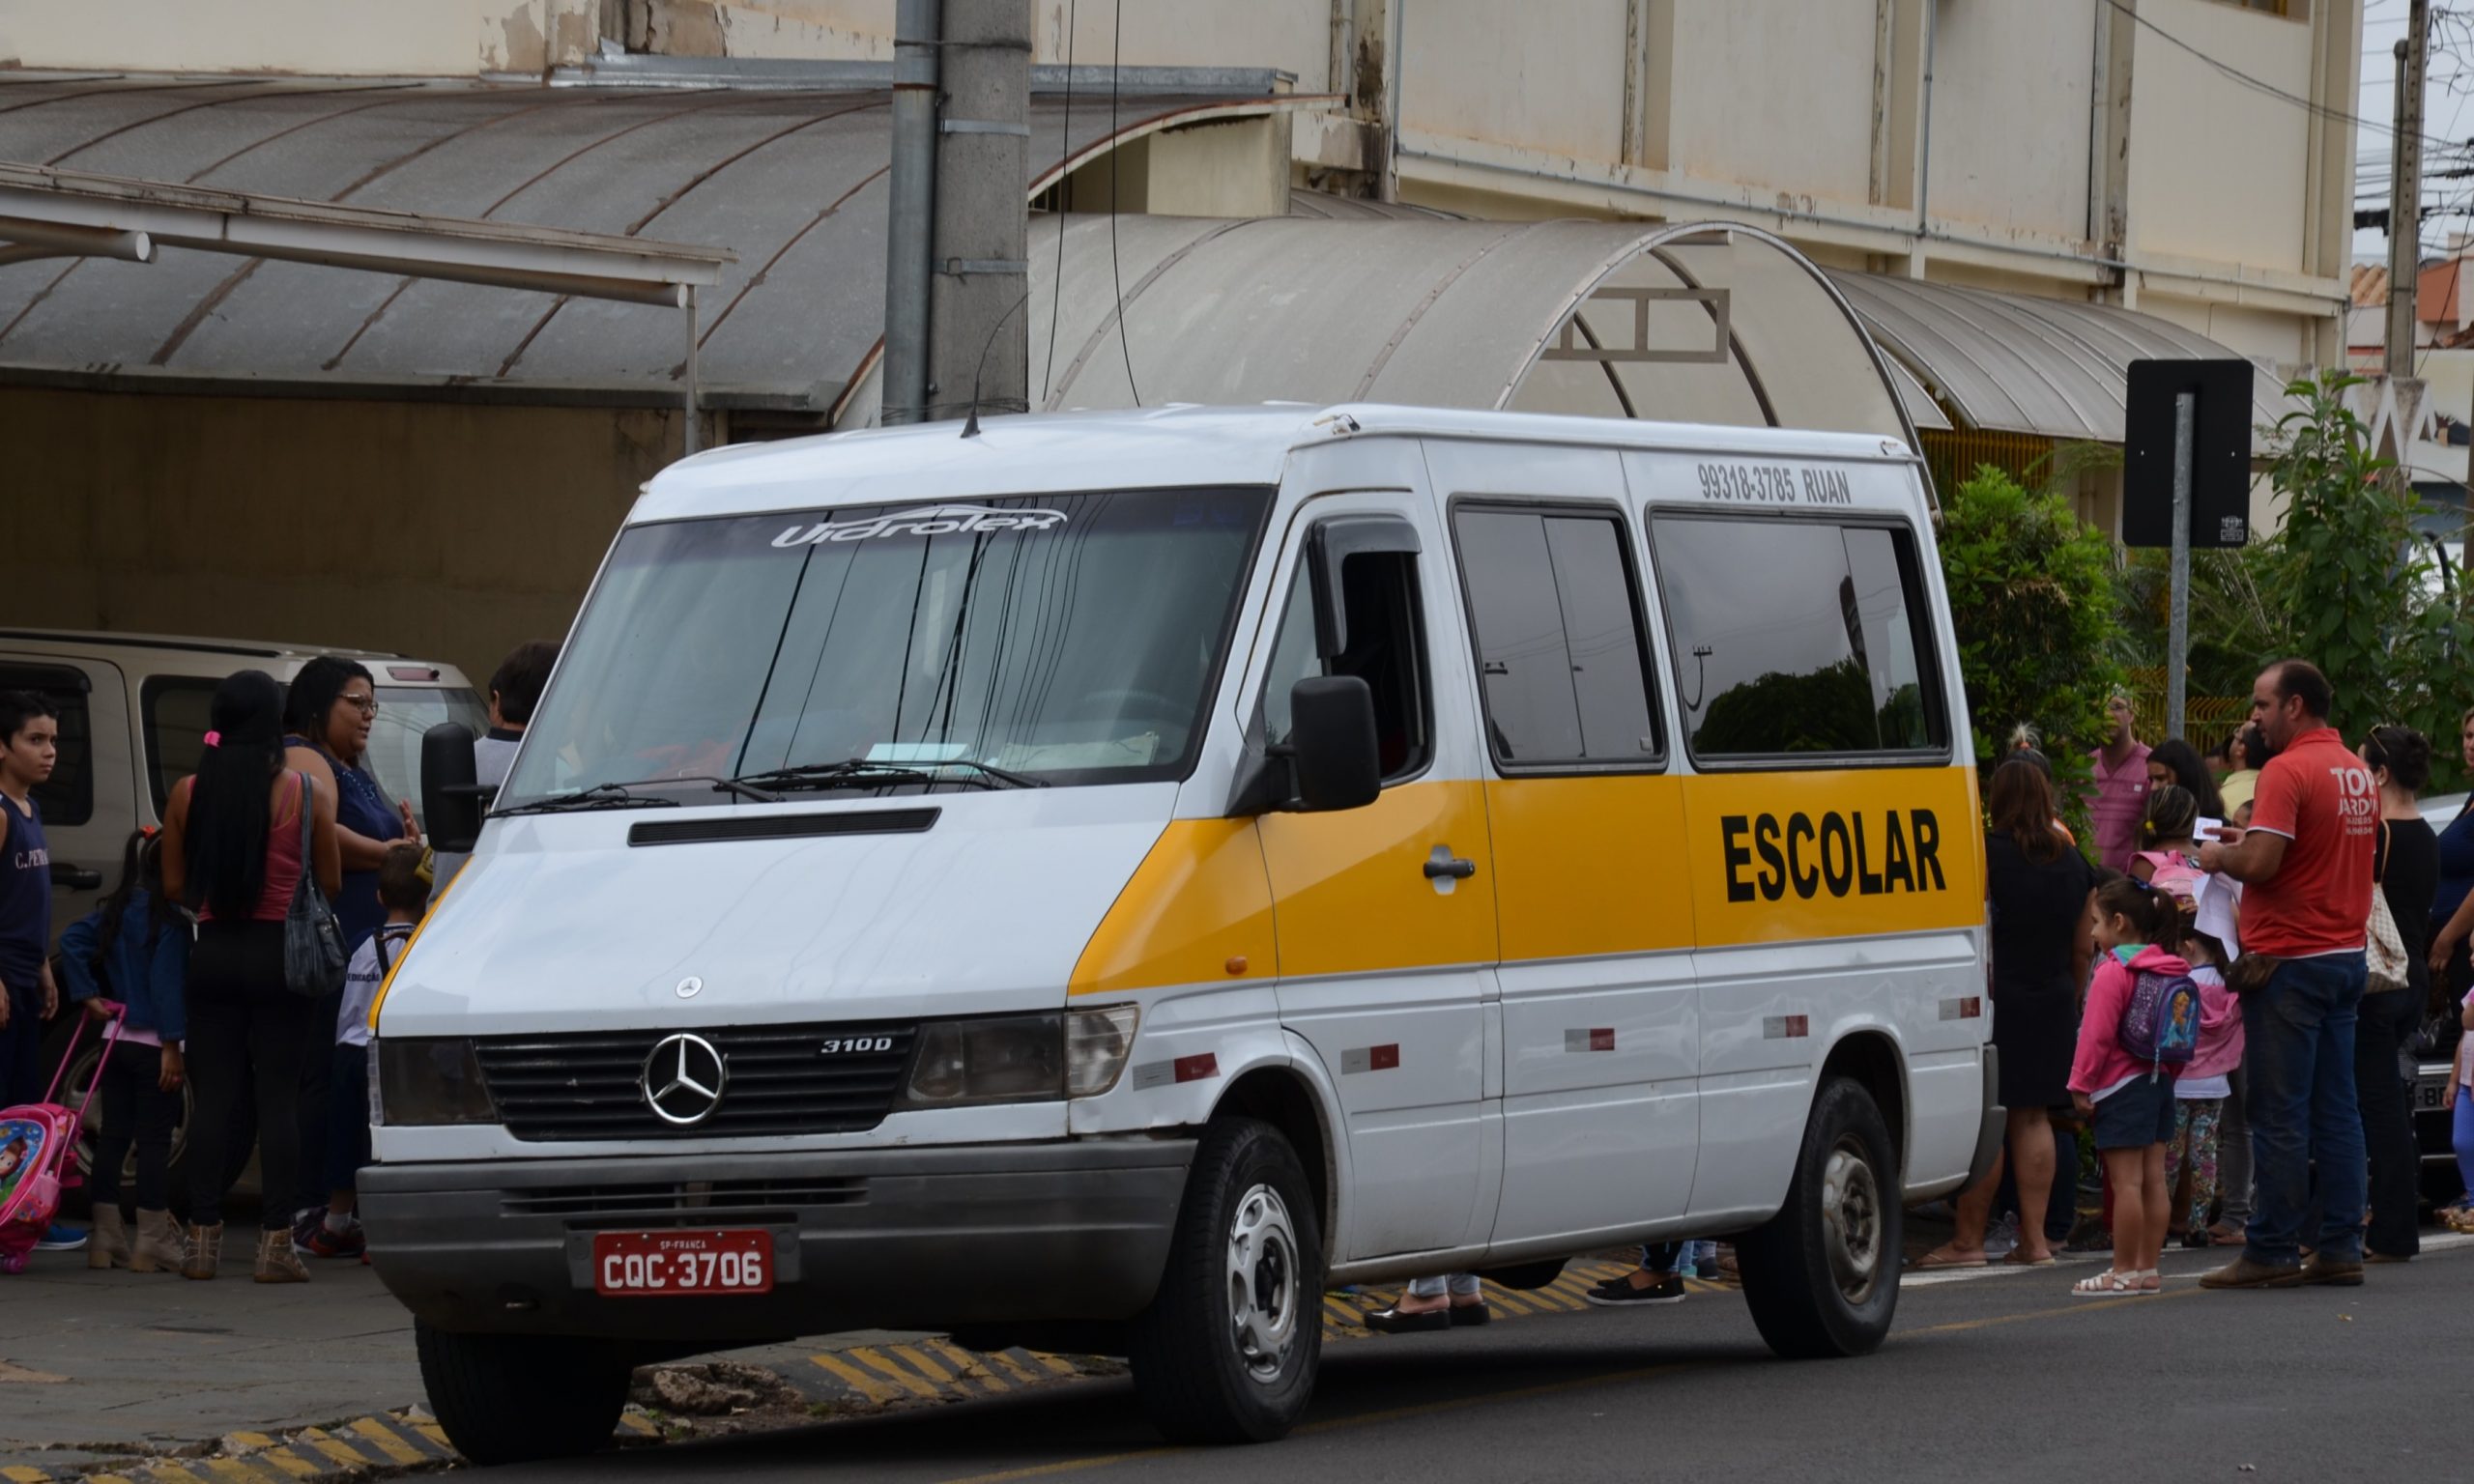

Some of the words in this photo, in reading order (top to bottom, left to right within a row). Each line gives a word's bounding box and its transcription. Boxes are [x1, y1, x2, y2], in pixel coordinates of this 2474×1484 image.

[1698, 463, 1796, 503] 99318-3785
[1801, 468, 1853, 505] RUAN
[1720, 808, 1947, 903] ESCOLAR
